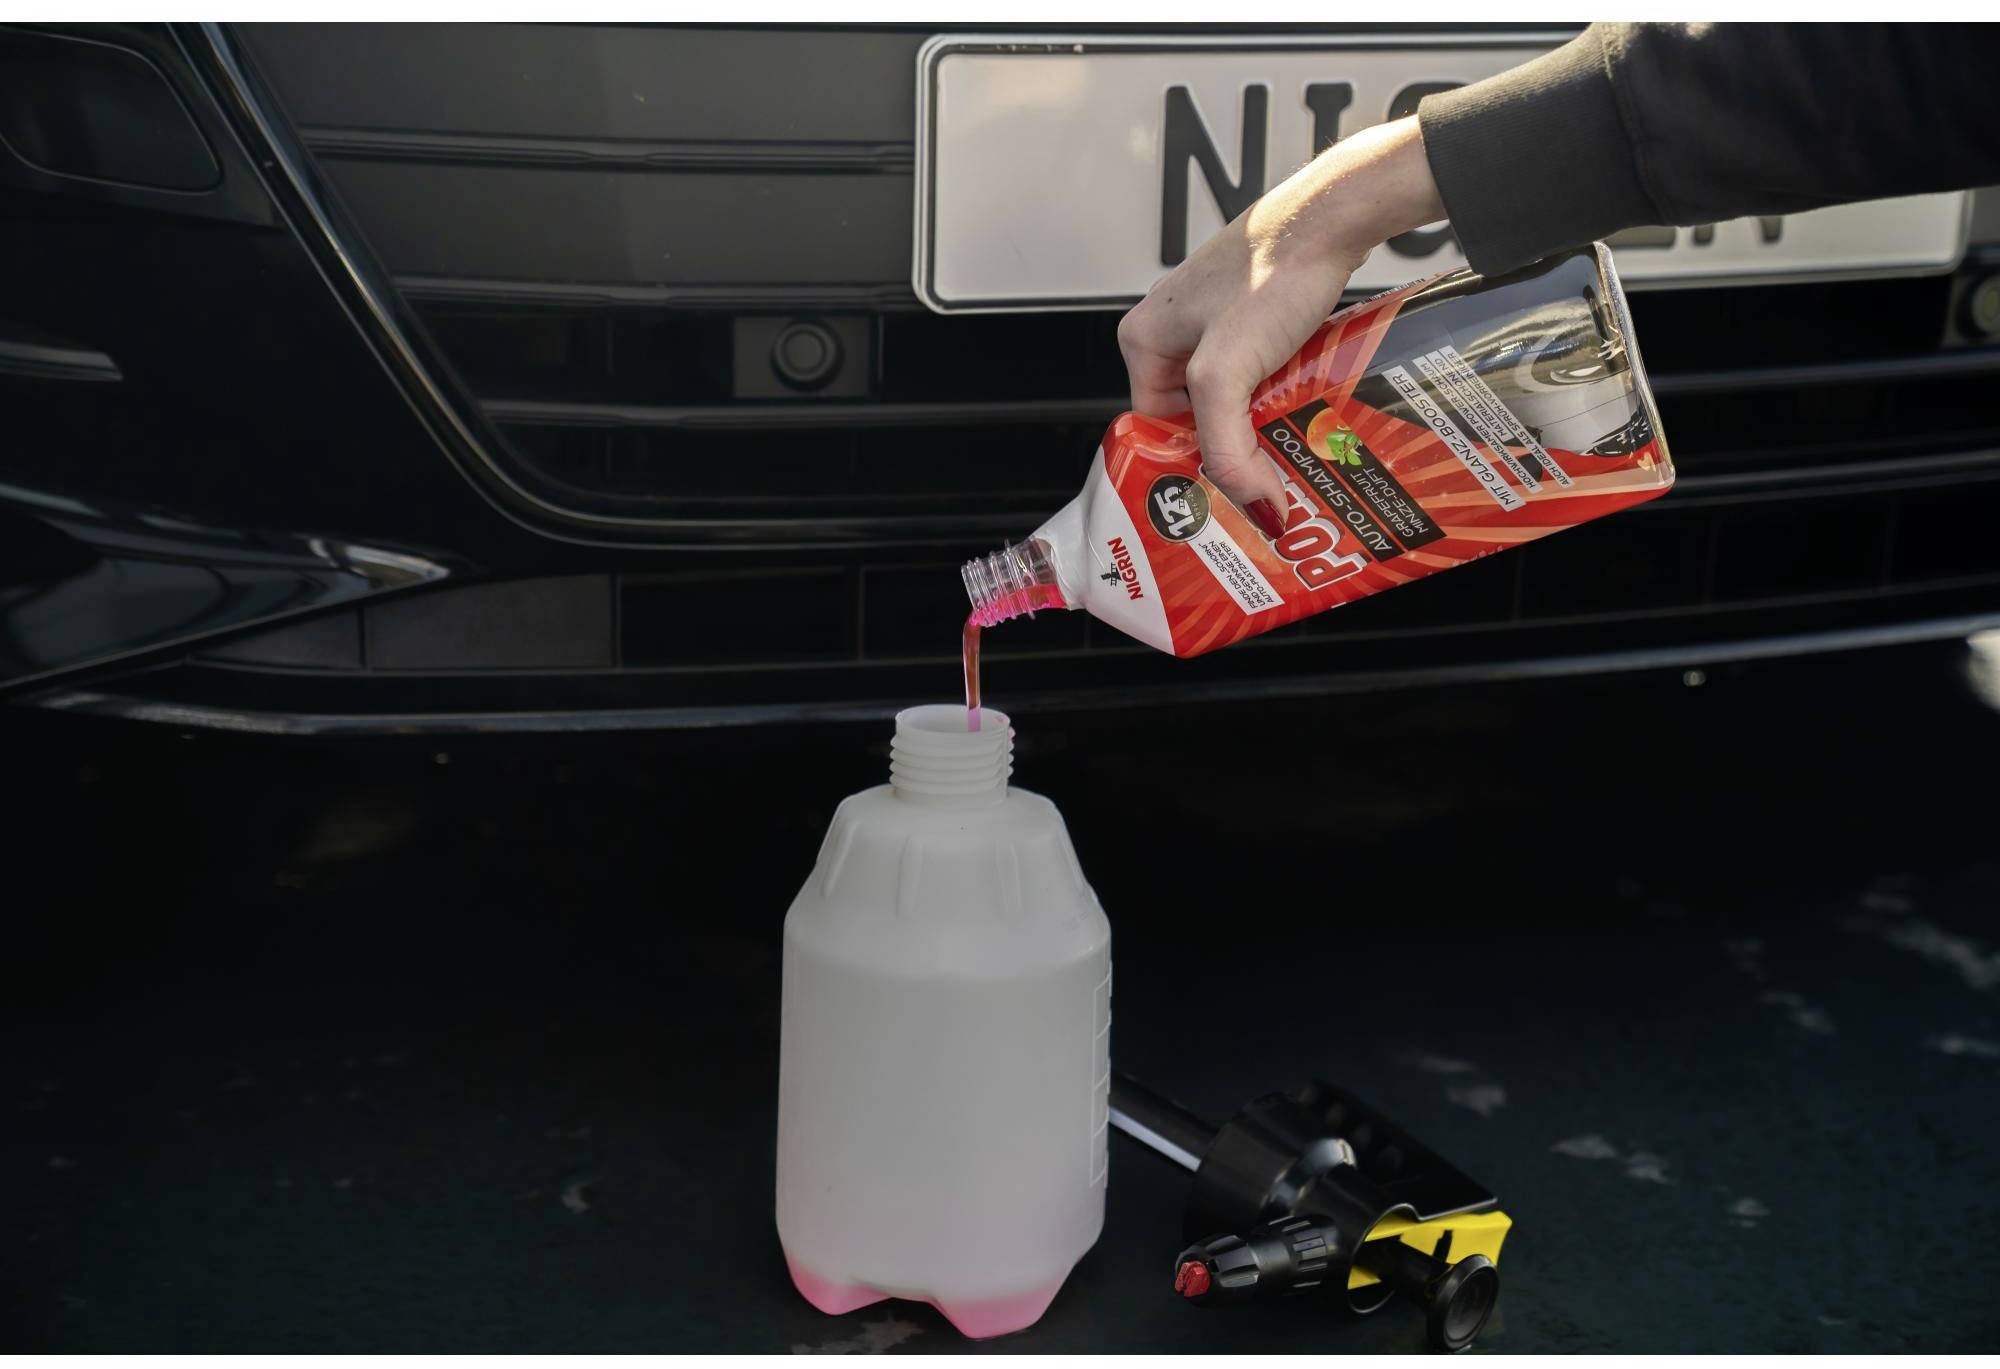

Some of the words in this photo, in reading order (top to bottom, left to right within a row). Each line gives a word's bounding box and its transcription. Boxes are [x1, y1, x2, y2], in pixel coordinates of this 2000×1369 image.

[1421, 362, 1479, 425] POWER-SCHAUM
[1434, 358, 1506, 436] MATERIALSCHONEND
[1392, 374, 1496, 482] GLANZ-BOOSTER
[1517, 430, 1534, 445] ALS
[1476, 422, 1536, 488] HOCHWIRKSAMER
[1530, 445, 1551, 466] IDEAL
[1272, 428, 1392, 551] AUTO-SHAMPOO
[1490, 486, 1516, 506] MIT
[1548, 466, 1569, 486] AUCH
[1154, 486, 1195, 536] 125
[1350, 473, 1414, 536] GRAPEFRUIT
[1363, 468, 1429, 534] MINZE-DUFT
[1107, 536, 1144, 600] NIGRIN
[1208, 540, 1228, 562] EINEN
[1226, 561, 1254, 591] GEWINNE
[1226, 575, 1242, 590] DEN
[1238, 589, 1258, 608] FINDE
[1252, 592, 1266, 606] UND
